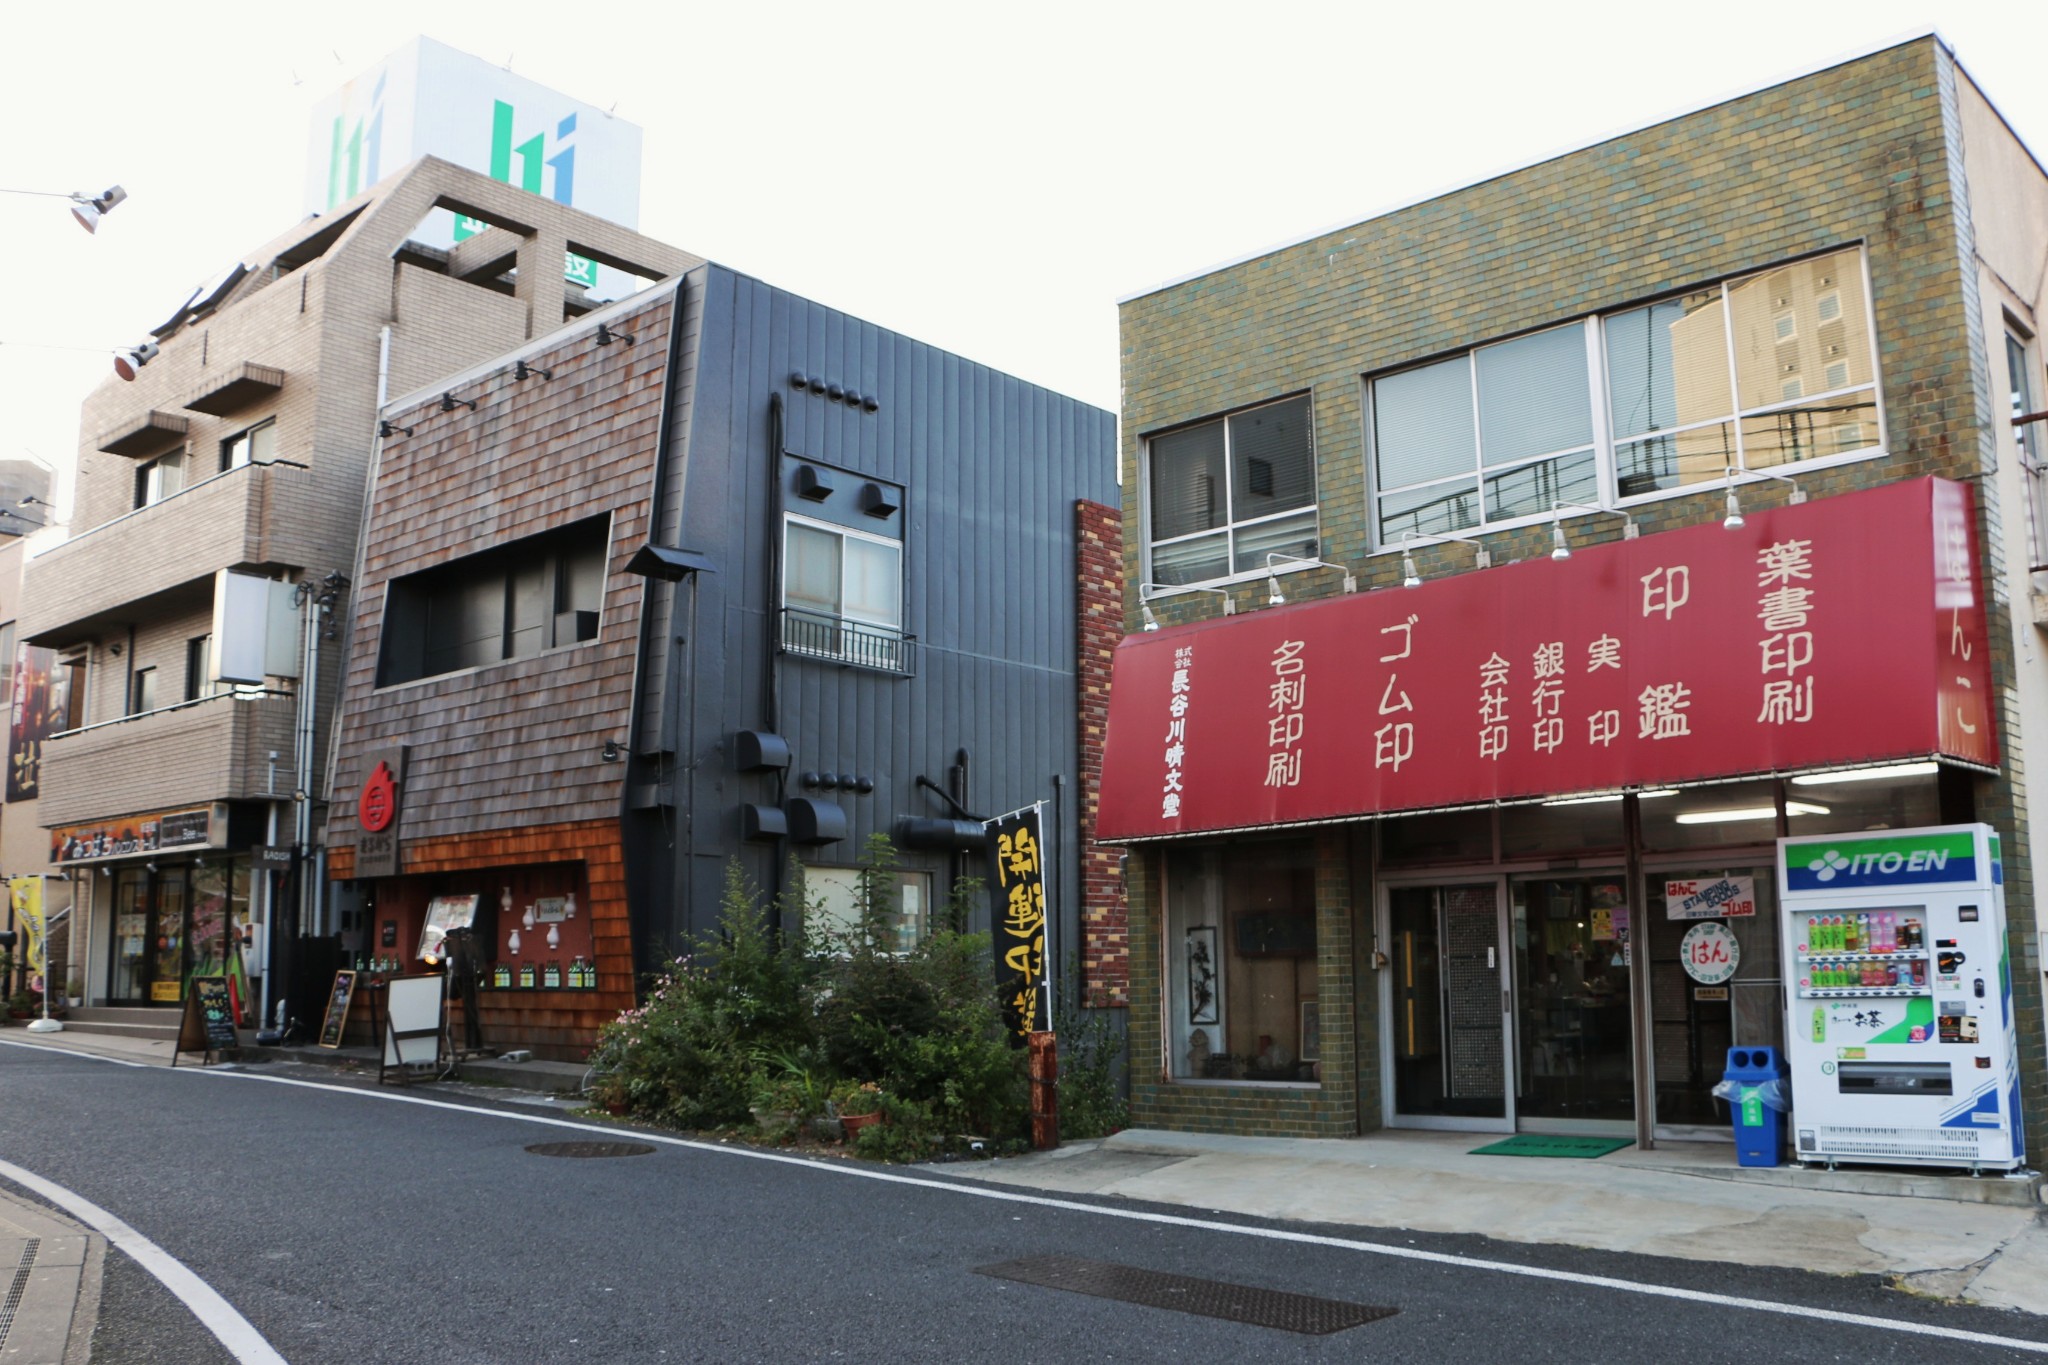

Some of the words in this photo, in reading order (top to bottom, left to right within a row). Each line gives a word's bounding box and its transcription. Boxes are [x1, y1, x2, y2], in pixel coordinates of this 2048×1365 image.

[1638, 564, 1692, 741] 印鑑
[1757, 539, 1815, 726] 葉書印刷
[1944, 519, 1976, 734] はんこ
[1162, 669, 1191, 819] 長谷川晴文堂
[1264, 639, 1306, 788] 名刺印刷
[1374, 613, 1419, 773] ゴム印
[1478, 651, 1511, 761] 会社印
[1532, 641, 1565, 754] 銀行印
[1587, 633, 1622, 748] 実印
[1667, 882, 1698, 897] はんこ
[1682, 879, 1730, 910] STAMPING
[1706, 884, 1741, 909] GOODS
[1721, 899, 1753, 916] ゴム印
[1850, 851, 1903, 876] ITO
[1906, 849, 1949, 872] EN
[1691, 940, 1729, 965] はん
